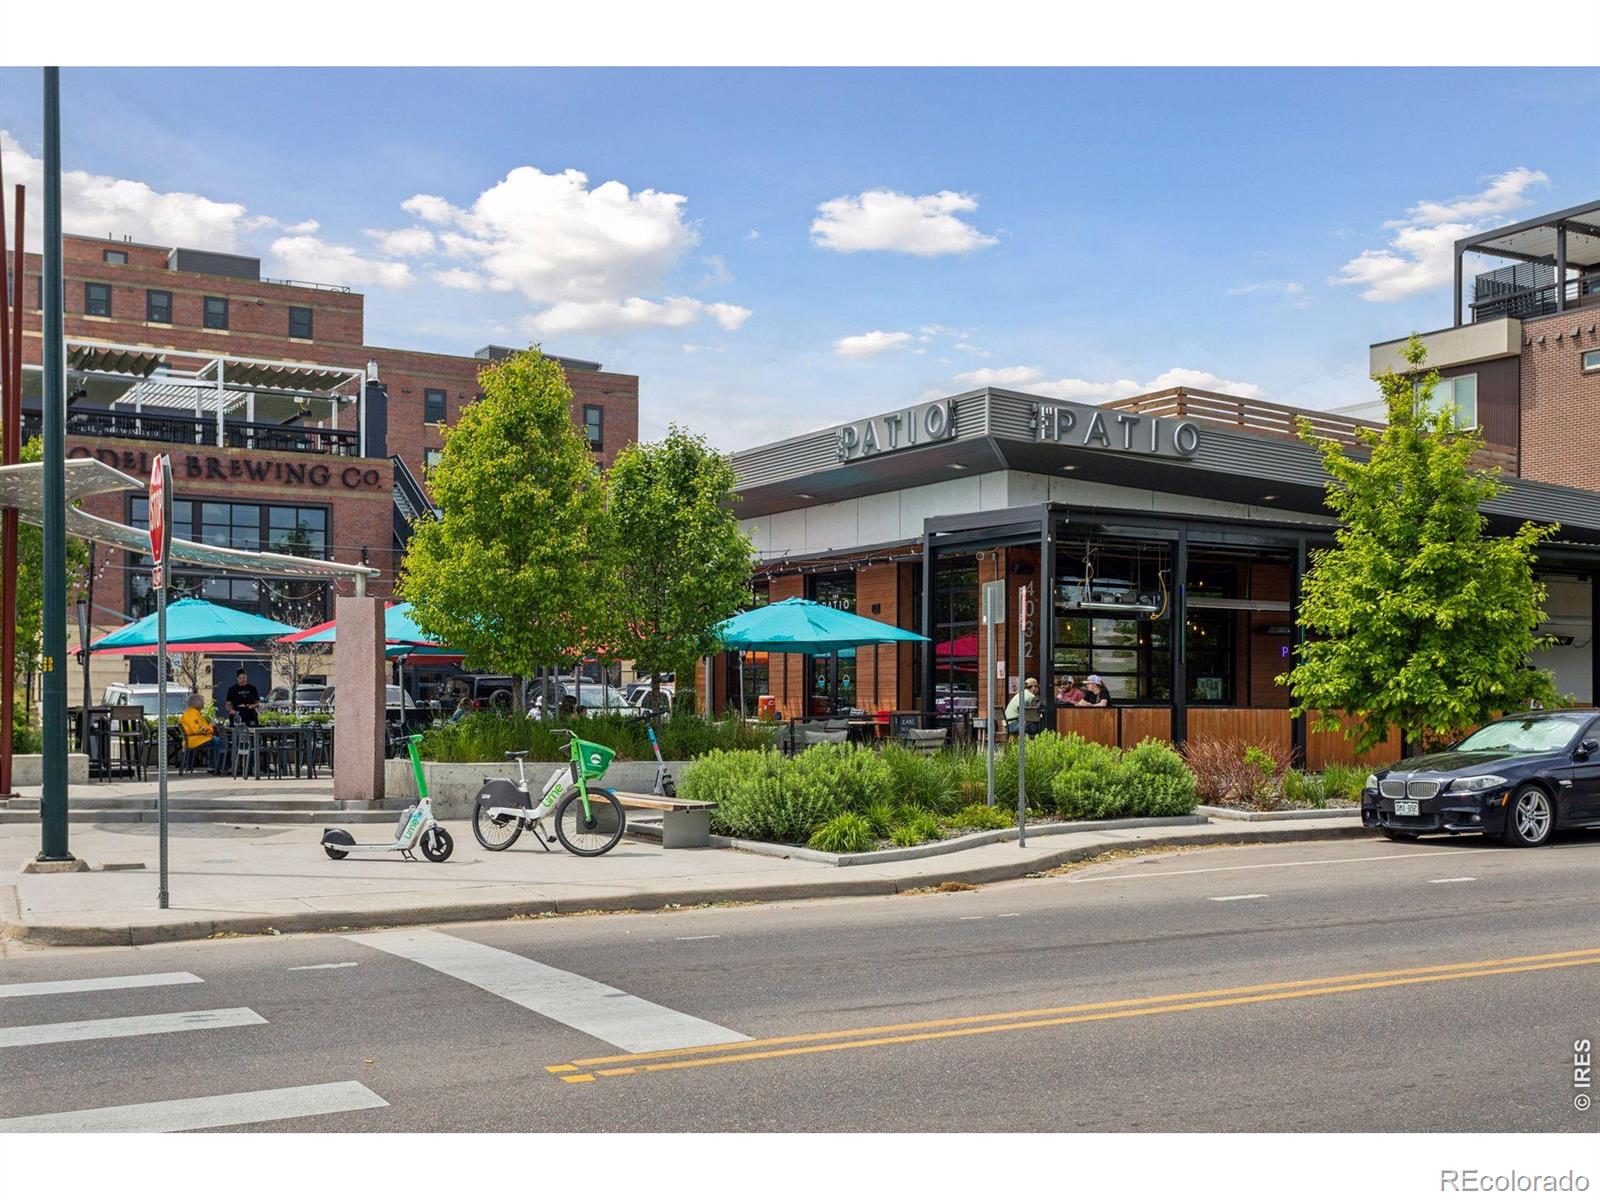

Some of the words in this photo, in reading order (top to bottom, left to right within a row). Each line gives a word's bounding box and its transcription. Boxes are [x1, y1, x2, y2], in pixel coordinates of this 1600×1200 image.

[842, 403, 948, 459] PATIO
[1053, 407, 1200, 456] PATIO
[186, 455, 331, 486] BREWING
[543, 783, 565, 808] Lime
[404, 814, 420, 840] Lime
